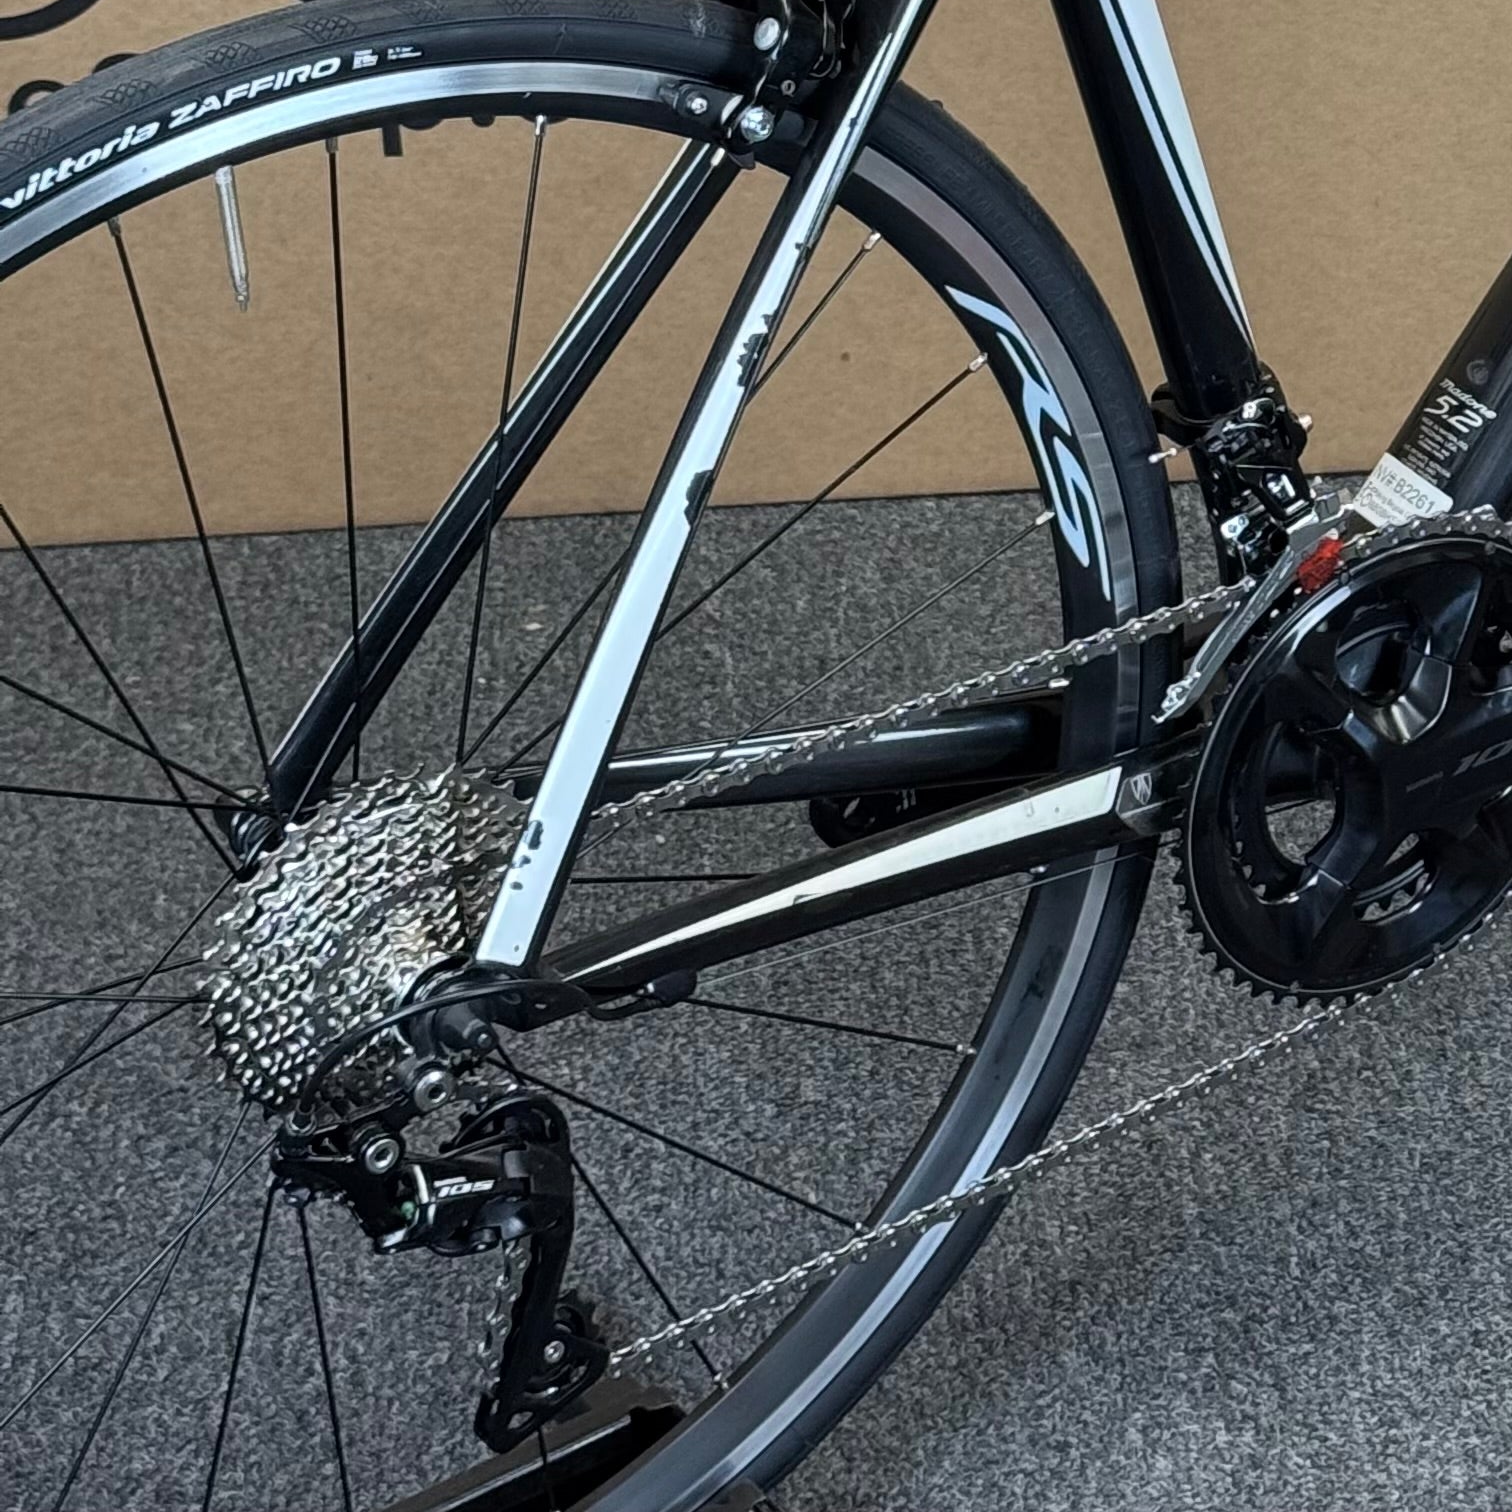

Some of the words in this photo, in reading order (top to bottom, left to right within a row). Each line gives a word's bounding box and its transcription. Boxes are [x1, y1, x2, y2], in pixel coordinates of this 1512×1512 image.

[168, 57, 341, 130] ZAFFIRO
[1424, 394, 1484, 434] 5.2
[437, 1179, 495, 1198] 105
